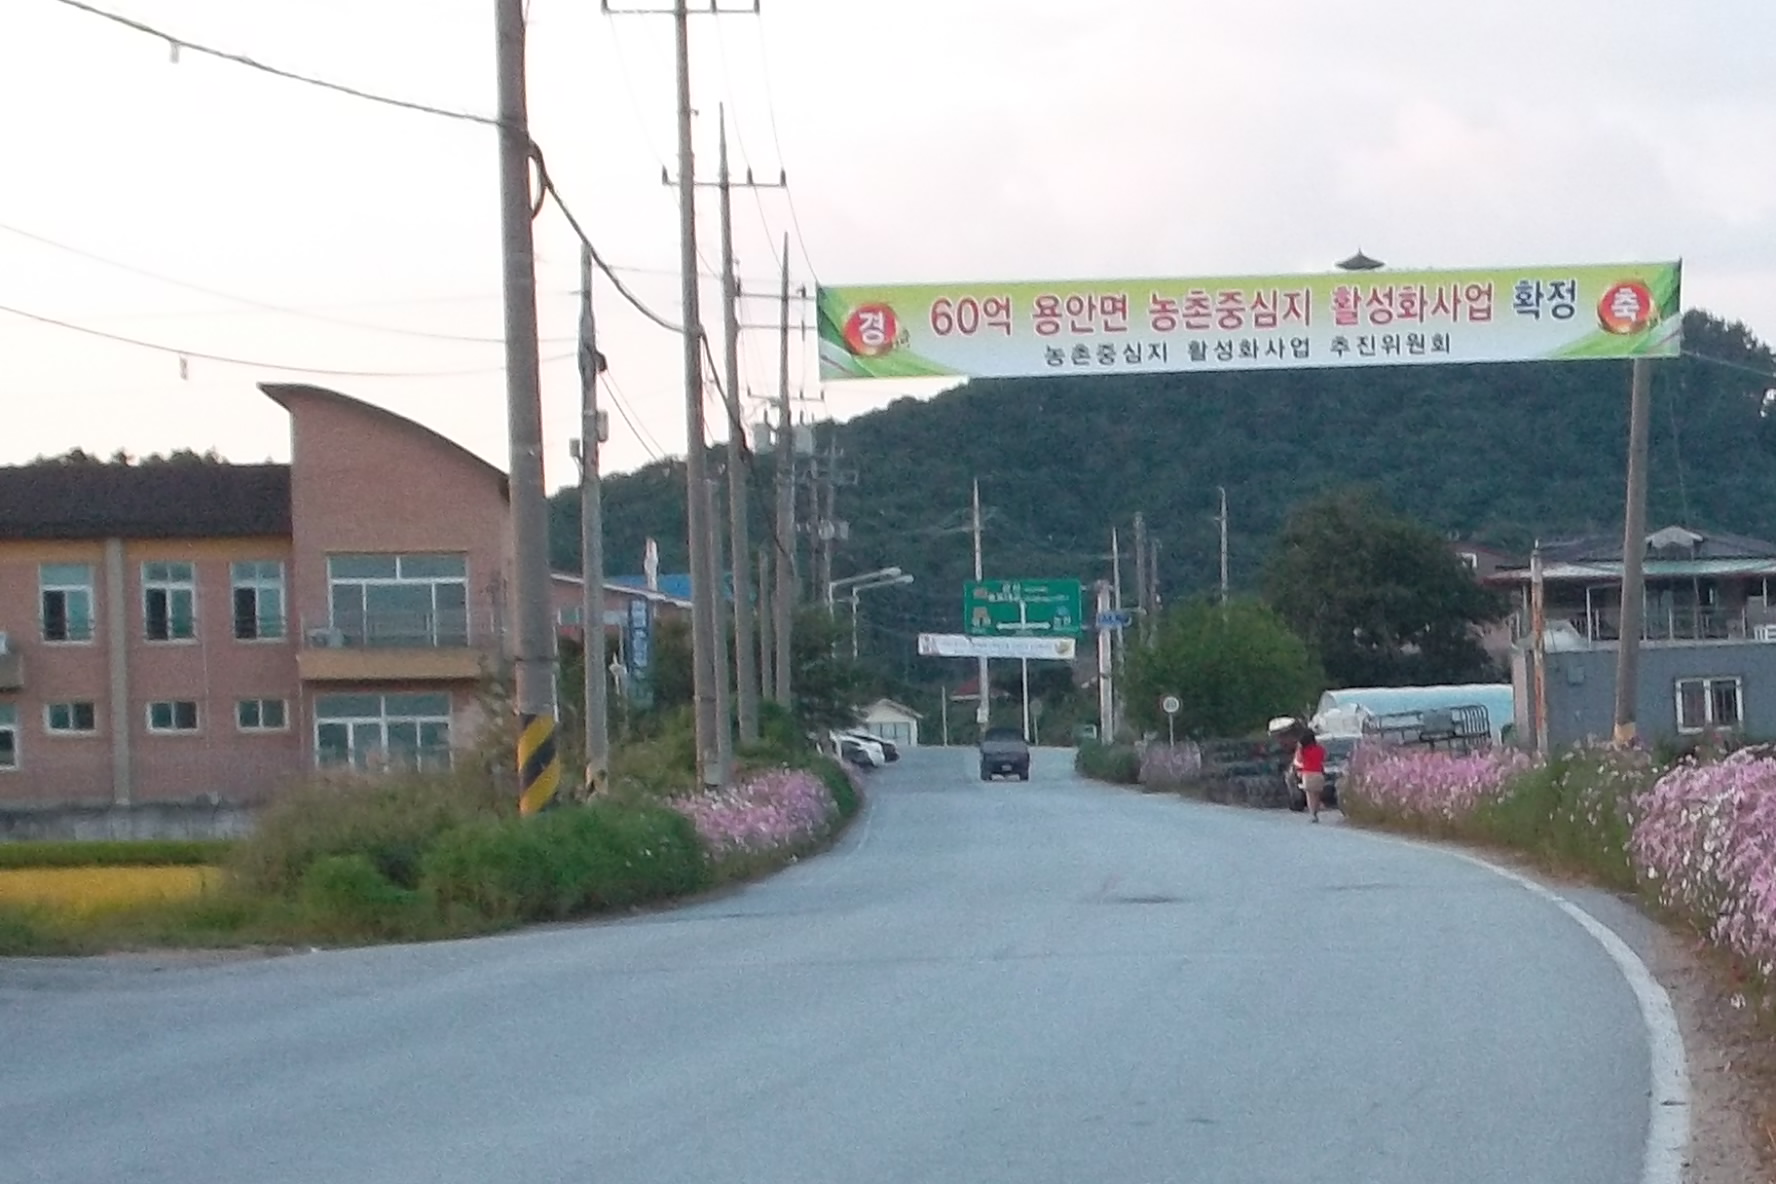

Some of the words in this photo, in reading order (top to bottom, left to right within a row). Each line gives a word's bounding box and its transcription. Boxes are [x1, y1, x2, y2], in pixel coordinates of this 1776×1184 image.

[931, 296, 1012, 337] 60억
[1032, 293, 1129, 336] 용안면
[1149, 287, 1311, 332] 농촌중심지
[1333, 281, 1494, 327] 활성화사업
[1513, 278, 1577, 320] 확정
[1609, 287, 1641, 324] 축
[859, 310, 885, 346] 경
[1045, 340, 1168, 367] 농촌중심지
[1188, 336, 1310, 363] 활성화사업
[1330, 331, 1451, 359] 추진위원회
